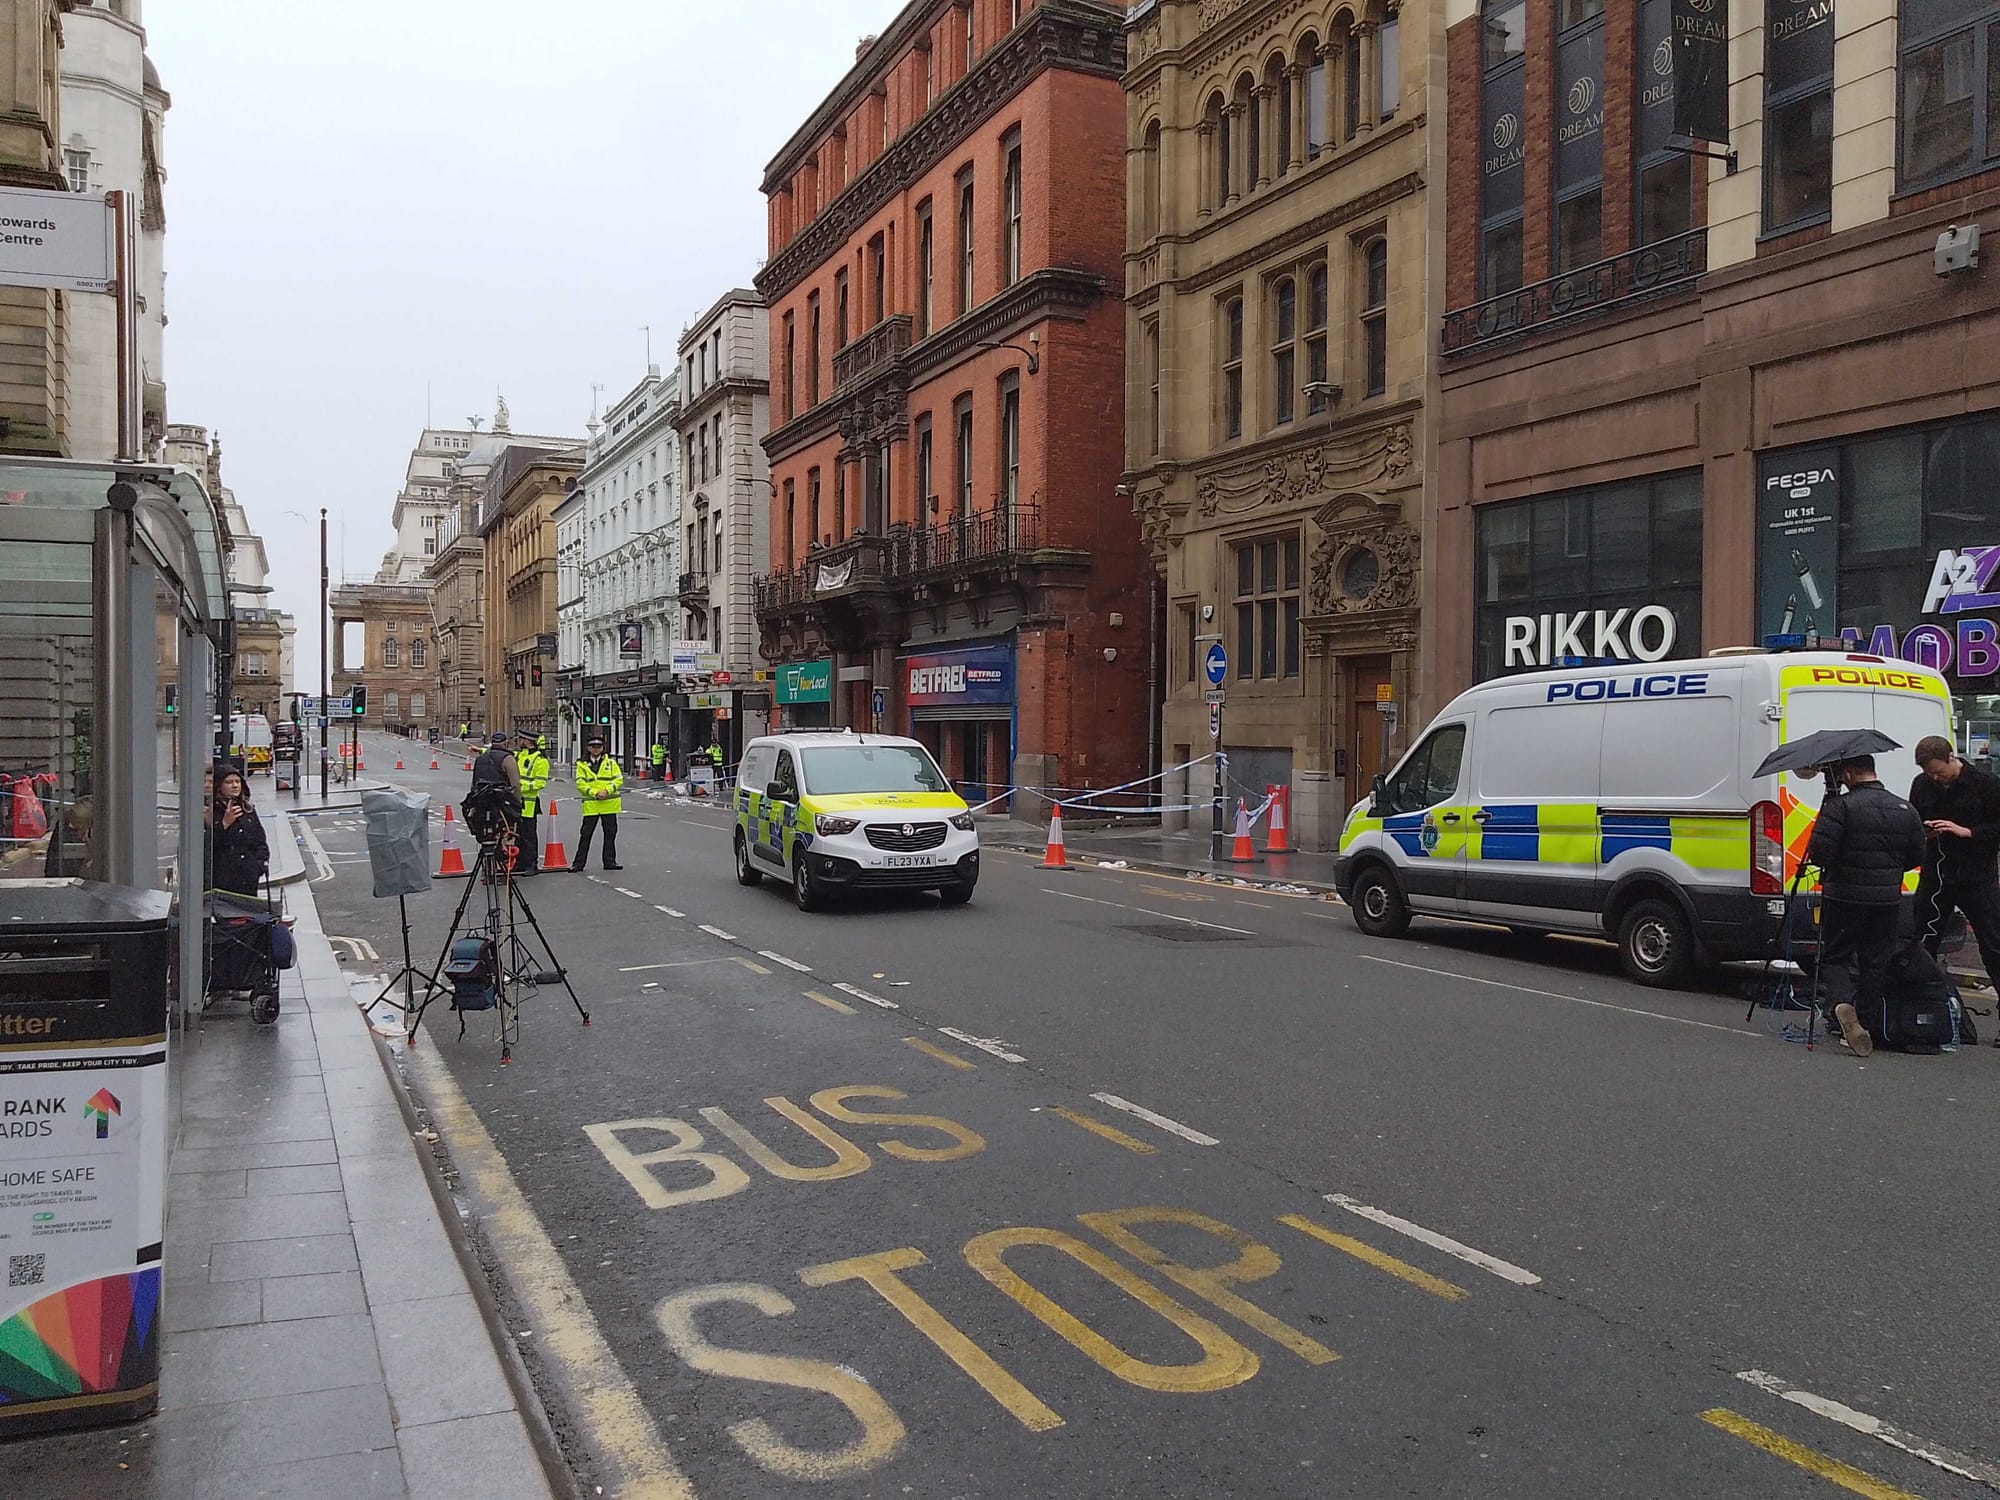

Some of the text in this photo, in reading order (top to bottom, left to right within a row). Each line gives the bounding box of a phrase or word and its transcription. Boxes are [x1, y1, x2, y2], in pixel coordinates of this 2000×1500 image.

[1675, 15, 1726, 40] DREAM
[1773, 0, 1834, 38] DREAM
[1559, 111, 1604, 141] DREAM
[1485, 145, 1526, 173] DREAM
[1784, 506, 1815, 518] UK 1st
[1505, 605, 1677, 667] RIKKO
[1547, 673, 1709, 702] POLICE
[1812, 668, 1924, 690] POLICE
[888, 856, 931, 867] FL23 YXA
[0, 1014, 58, 1035] tter
[4, 1098, 66, 1116] RANK
[582, 1085, 986, 1209] BUS
[52, 1168, 95, 1182] SAFE
[656, 1207, 1342, 1480] STOP
